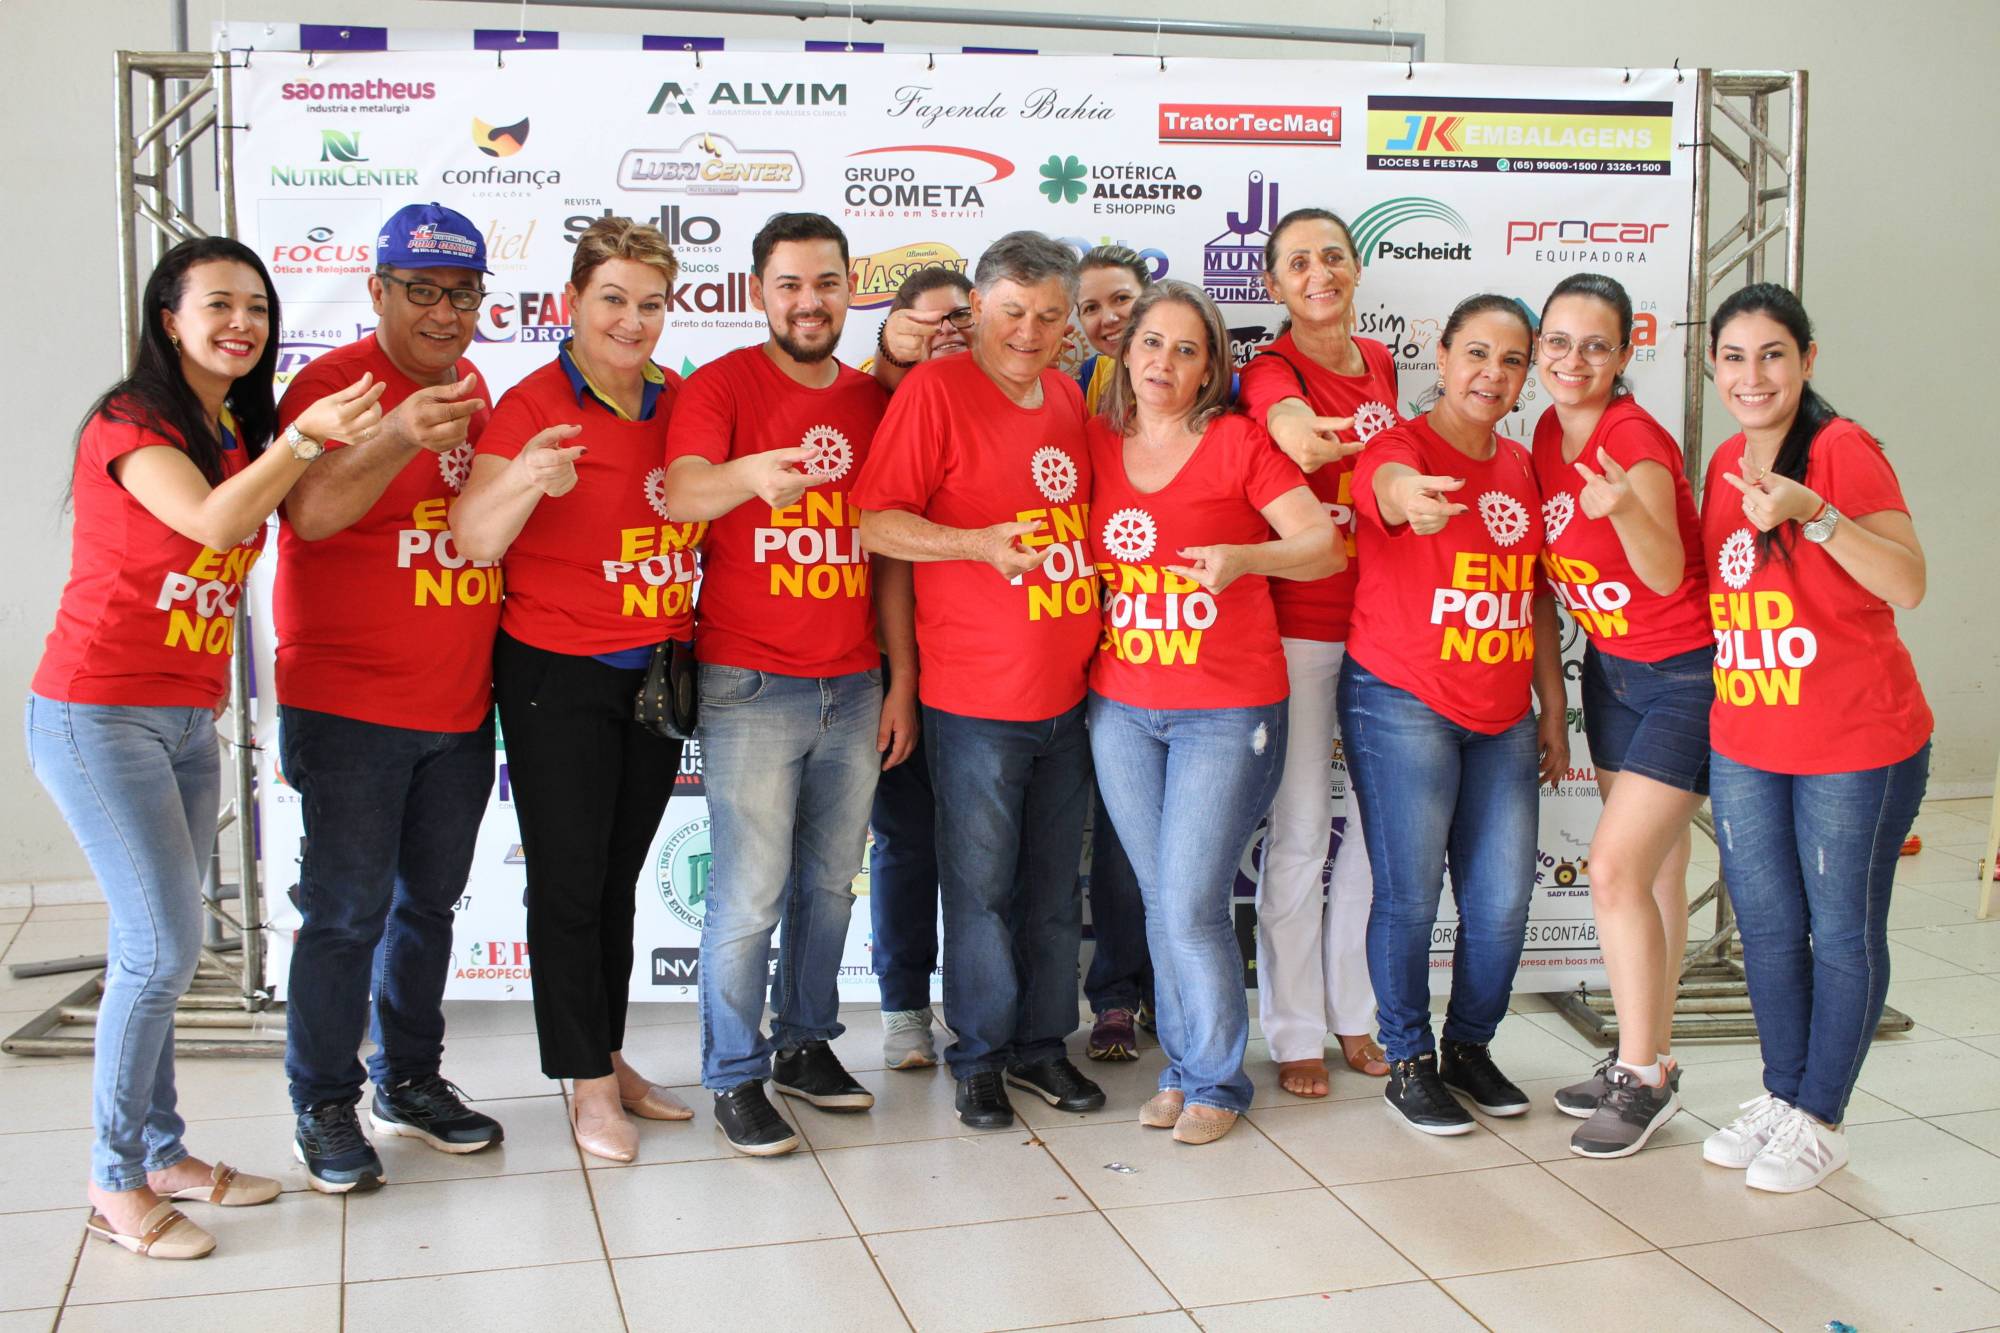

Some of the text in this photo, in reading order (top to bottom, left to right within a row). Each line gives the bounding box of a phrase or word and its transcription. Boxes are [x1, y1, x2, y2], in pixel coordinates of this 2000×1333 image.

[328, 79, 436, 100] matheus
[708, 83, 847, 106] ALVIM
[306, 104, 349, 113] industria
[359, 104, 410, 114] metalurgia
[886, 85, 1116, 128] Fazenda Bahia
[1164, 111, 1334, 138] TratorTecMaq
[1386, 115, 1652, 152] JK EMBALAGENS
[1092, 162, 1177, 180] LOTÉRICA
[1378, 158, 1420, 168] DOCES
[1423, 159, 1430, 168] E
[1434, 159, 1479, 169] FESTAS
[1513, 160, 1534, 171] (65)
[1536, 161, 1598, 172] 99609-1500
[1606, 162, 1661, 172] 3326-1500
[442, 166, 561, 189] confiança
[845, 168, 915, 182] GRUPO
[845, 185, 985, 207] COMETA
[1093, 183, 1202, 200] ALCASTRO
[845, 208, 984, 218] Paixão em Servir!
[1093, 203, 1176, 215] E SHOPPING
[272, 245, 369, 262] FOCUS
[1378, 241, 1472, 262] Pscheidt
[1535, 249, 1647, 263] EQUIPADORA
[681, 262, 720, 273] Sucos
[1640, 301, 1657, 310] DA
[671, 320, 699, 328] direto
[701, 320, 714, 328] da
[715, 320, 753, 328] fazenda
[1709, 590, 1794, 631] END
[1541, 923, 1599, 941] CONTÁB
[1565, 955, 1588, 966] boas
